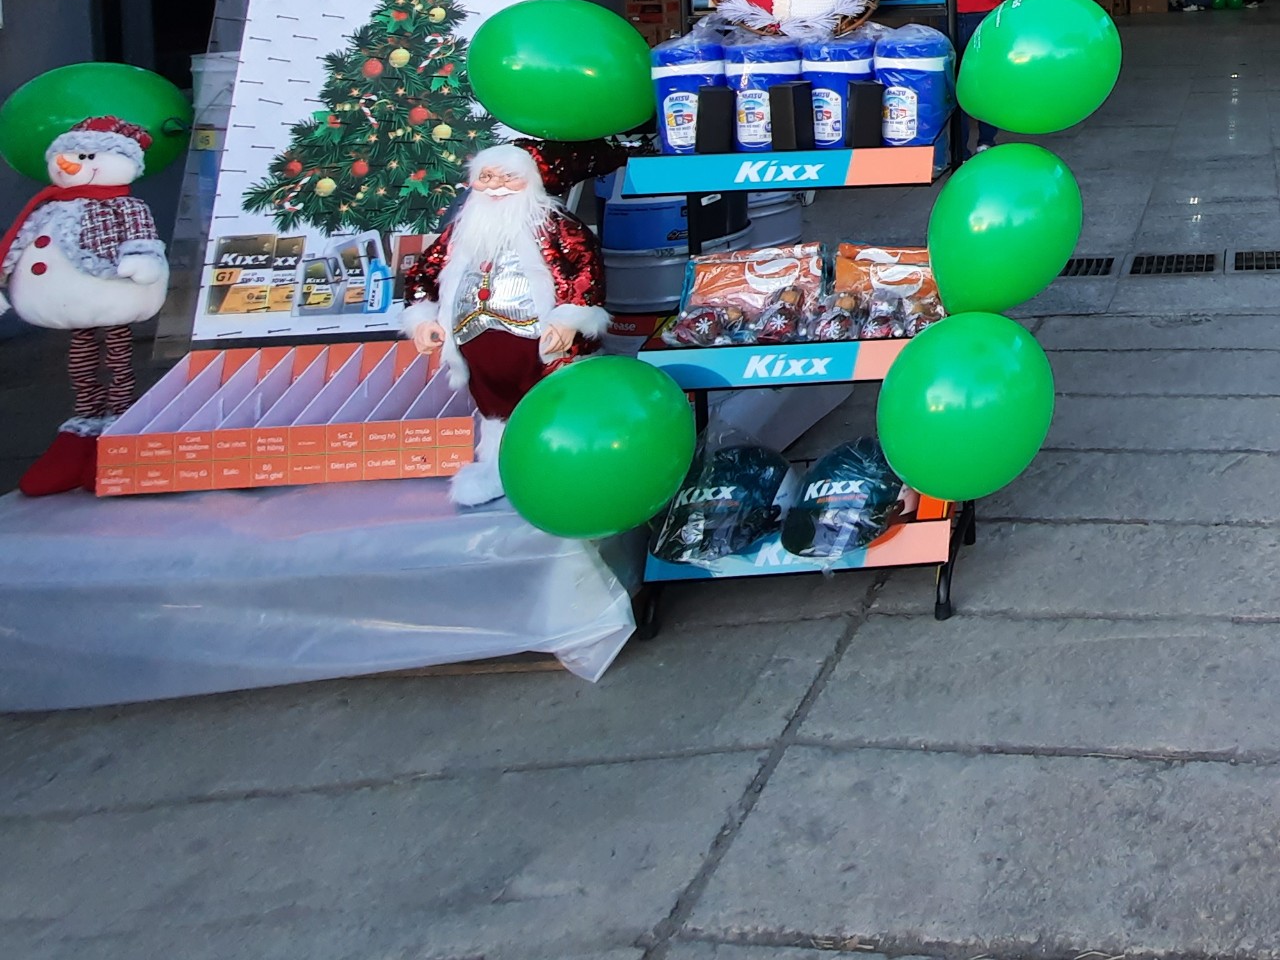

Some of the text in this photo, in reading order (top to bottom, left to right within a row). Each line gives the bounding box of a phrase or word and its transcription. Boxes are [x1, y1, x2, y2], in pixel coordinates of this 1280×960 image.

[734, 160, 825, 183] Kixx
[220, 253, 270, 266] Kixx
[273, 256, 300, 266] xx
[216, 272, 234, 282] G1
[369, 289, 377, 308] Kixx
[609, 322, 637, 332] rease
[742, 353, 834, 379] Kixx
[676, 486, 737, 509] Kixx
[804, 479, 866, 502] Kixx
